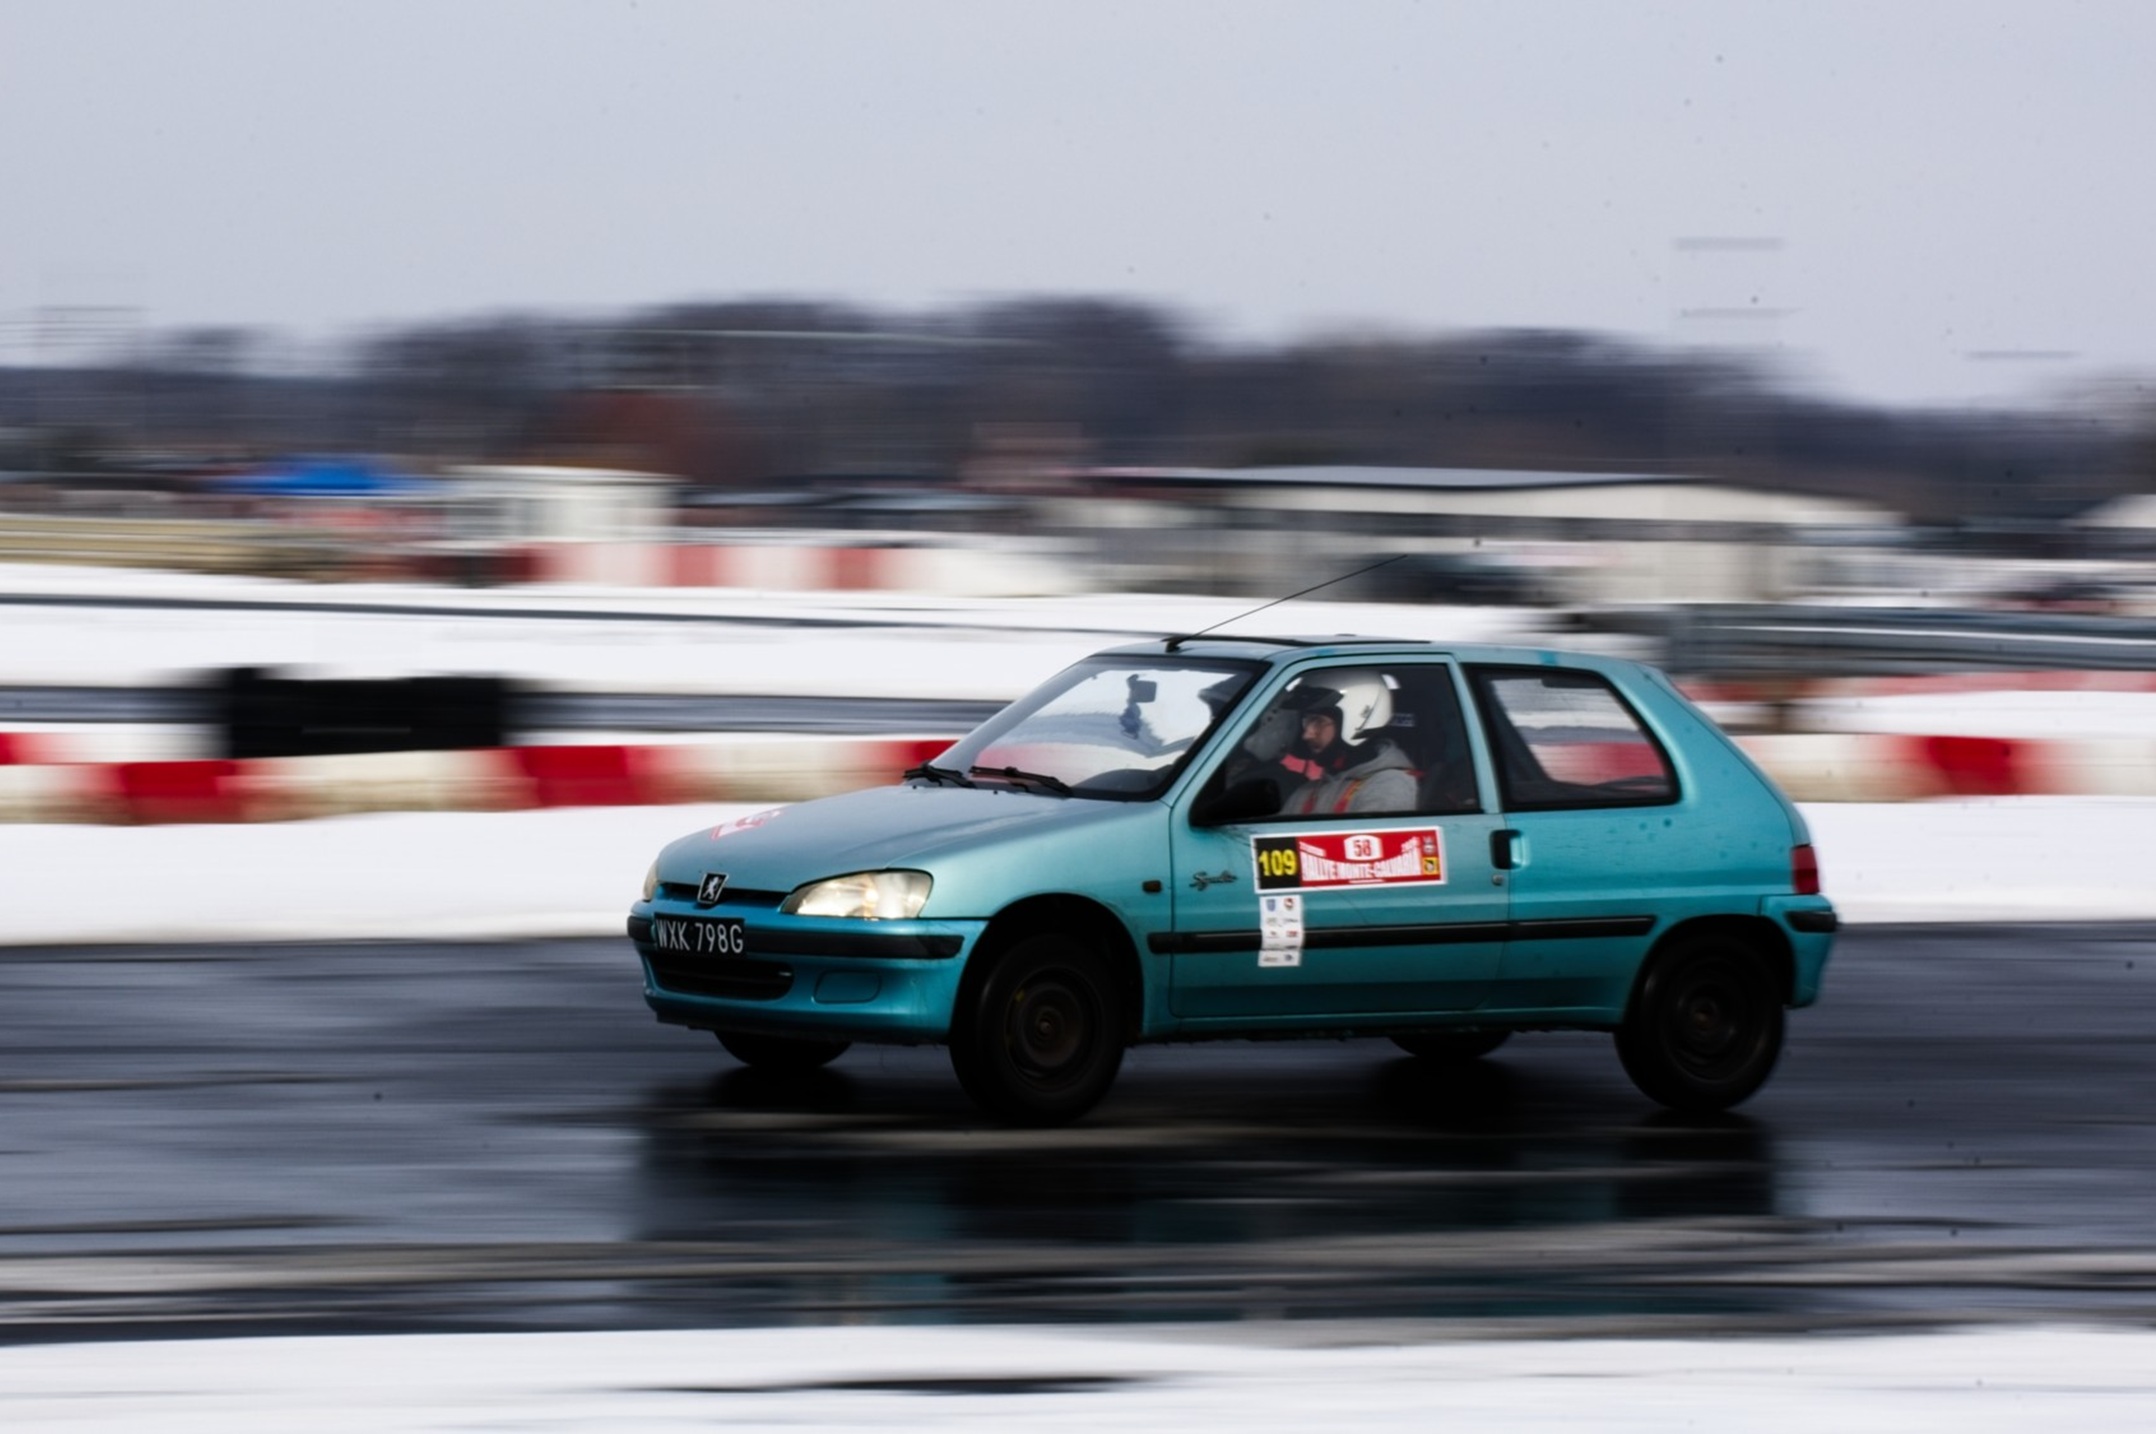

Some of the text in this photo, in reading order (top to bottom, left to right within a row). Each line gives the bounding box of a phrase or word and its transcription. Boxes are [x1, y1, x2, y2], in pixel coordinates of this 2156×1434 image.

[1353, 838, 1373, 858] 58
[1259, 849, 1297, 877] 109
[1301, 852, 1337, 880] RALLYE
[655, 918, 744, 954] WXK 798G
